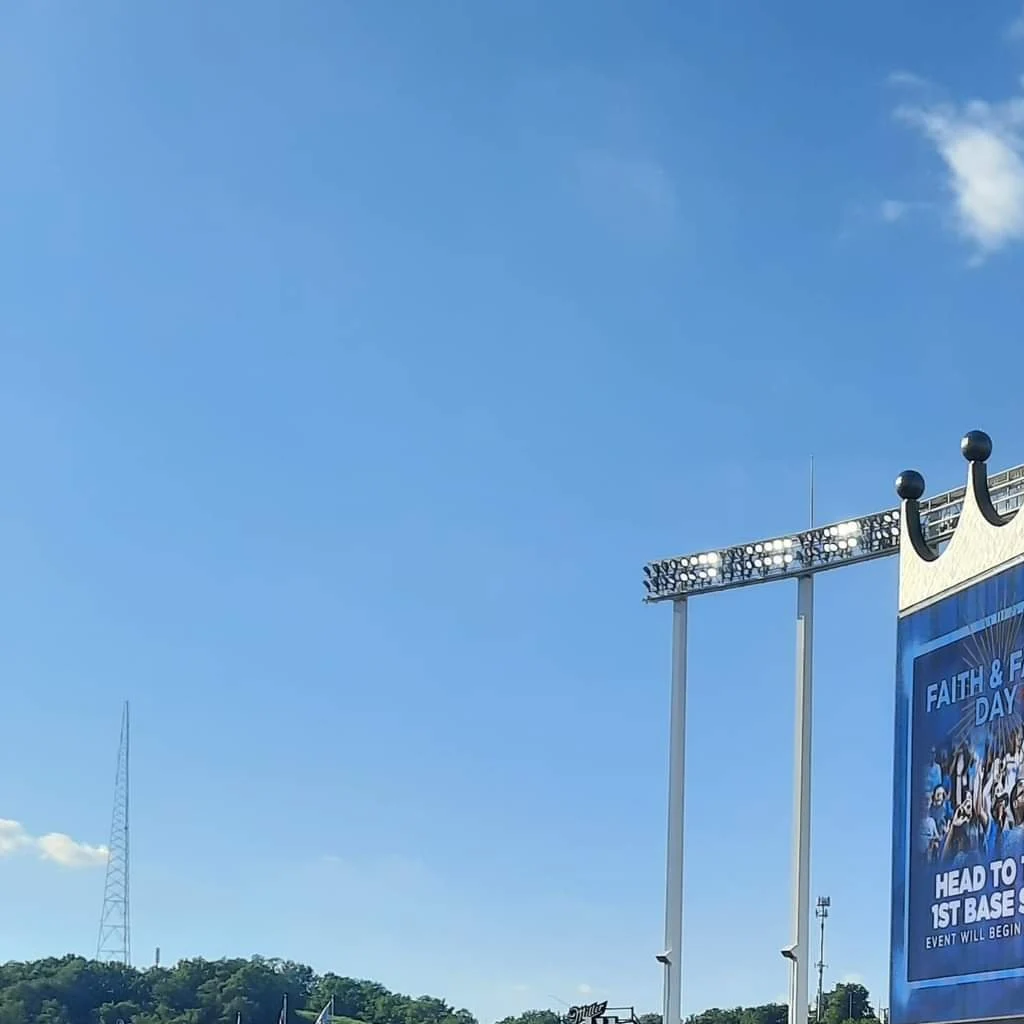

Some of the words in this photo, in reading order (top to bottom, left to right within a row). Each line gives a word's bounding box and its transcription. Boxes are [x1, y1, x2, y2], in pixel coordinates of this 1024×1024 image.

[926, 664, 983, 713] FAITH
[989, 658, 1004, 689] &
[975, 684, 1018, 726] DAY
[935, 865, 986, 899] HEAD
[990, 857, 1017, 888] TO
[931, 900, 961, 929] 1ST
[964, 889, 1015, 924] BASE
[926, 933, 956, 949] EVENT
[960, 927, 985, 944] WILL
[989, 921, 1021, 939] BEGIN
[569, 1001, 608, 1023] Miller
